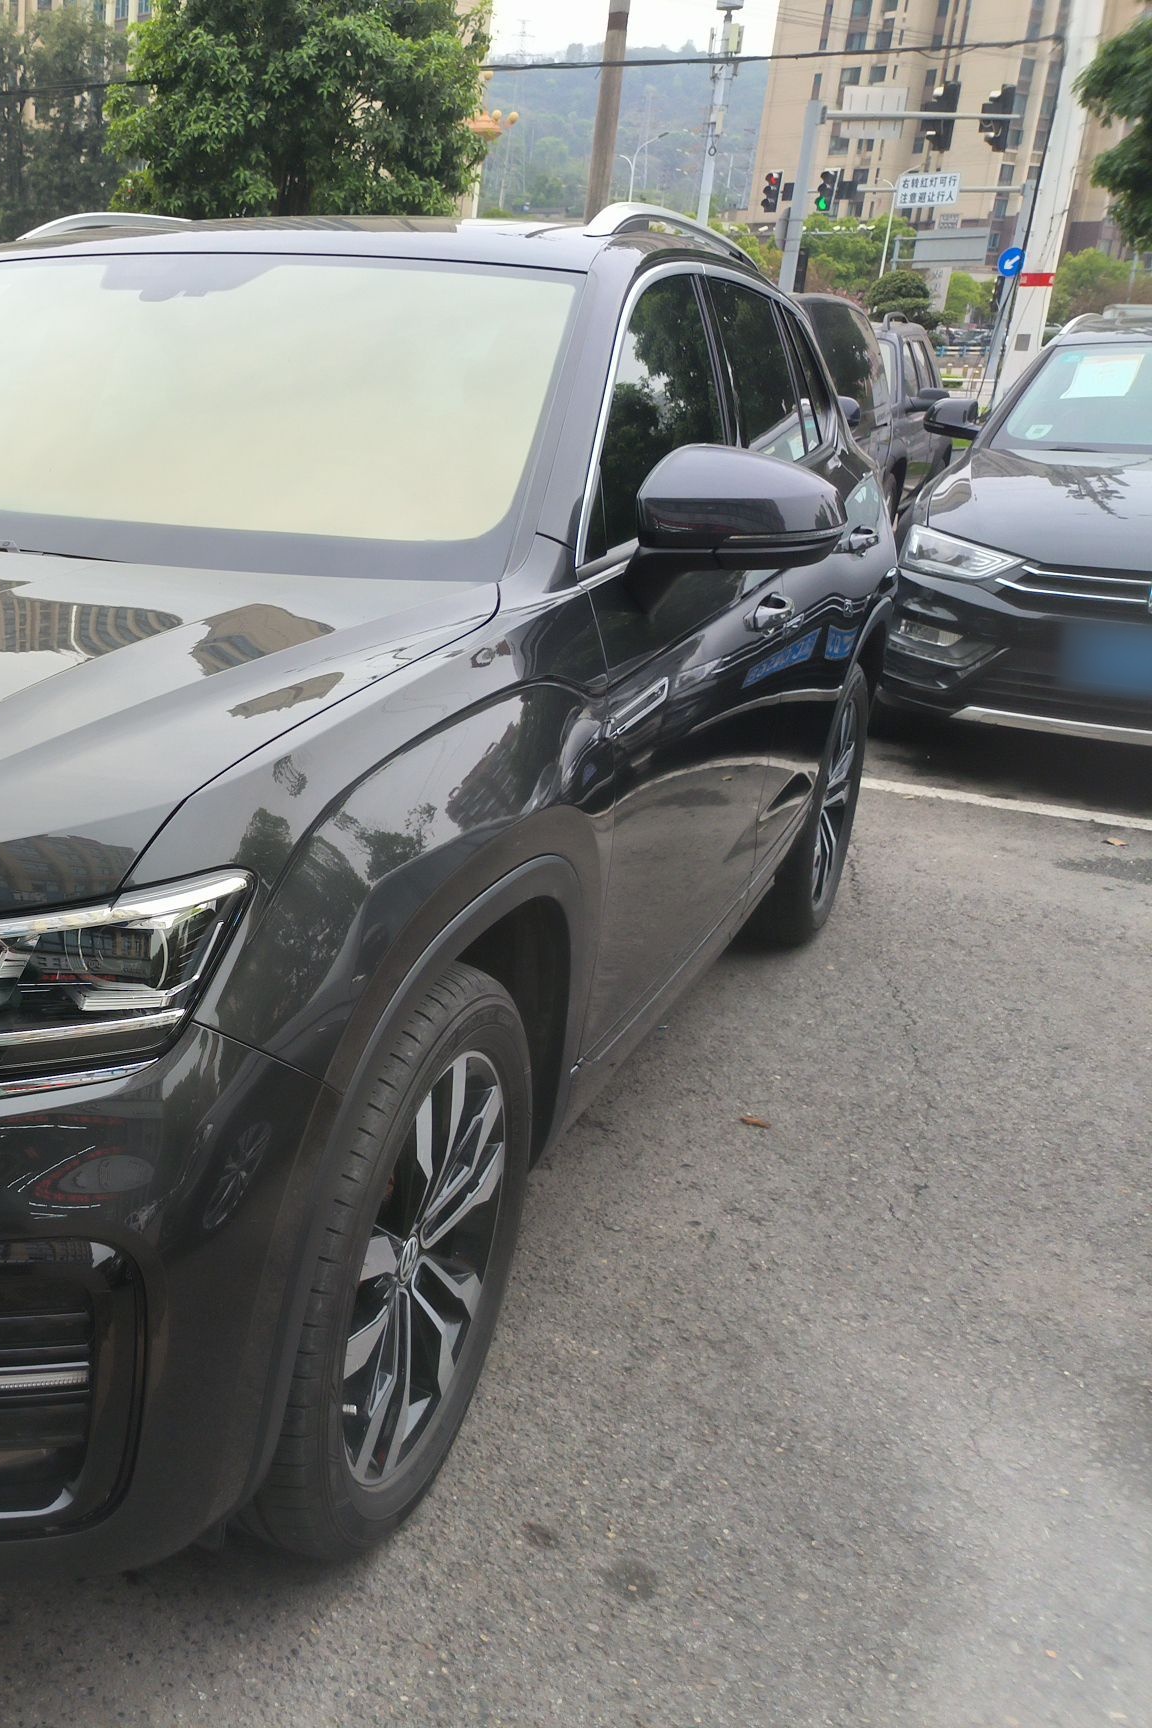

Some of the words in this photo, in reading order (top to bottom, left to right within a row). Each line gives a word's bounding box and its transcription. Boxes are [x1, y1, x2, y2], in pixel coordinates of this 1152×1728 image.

[902, 175, 957, 188] 右转红灯可行
[899, 190, 954, 203] 注意避让行人
